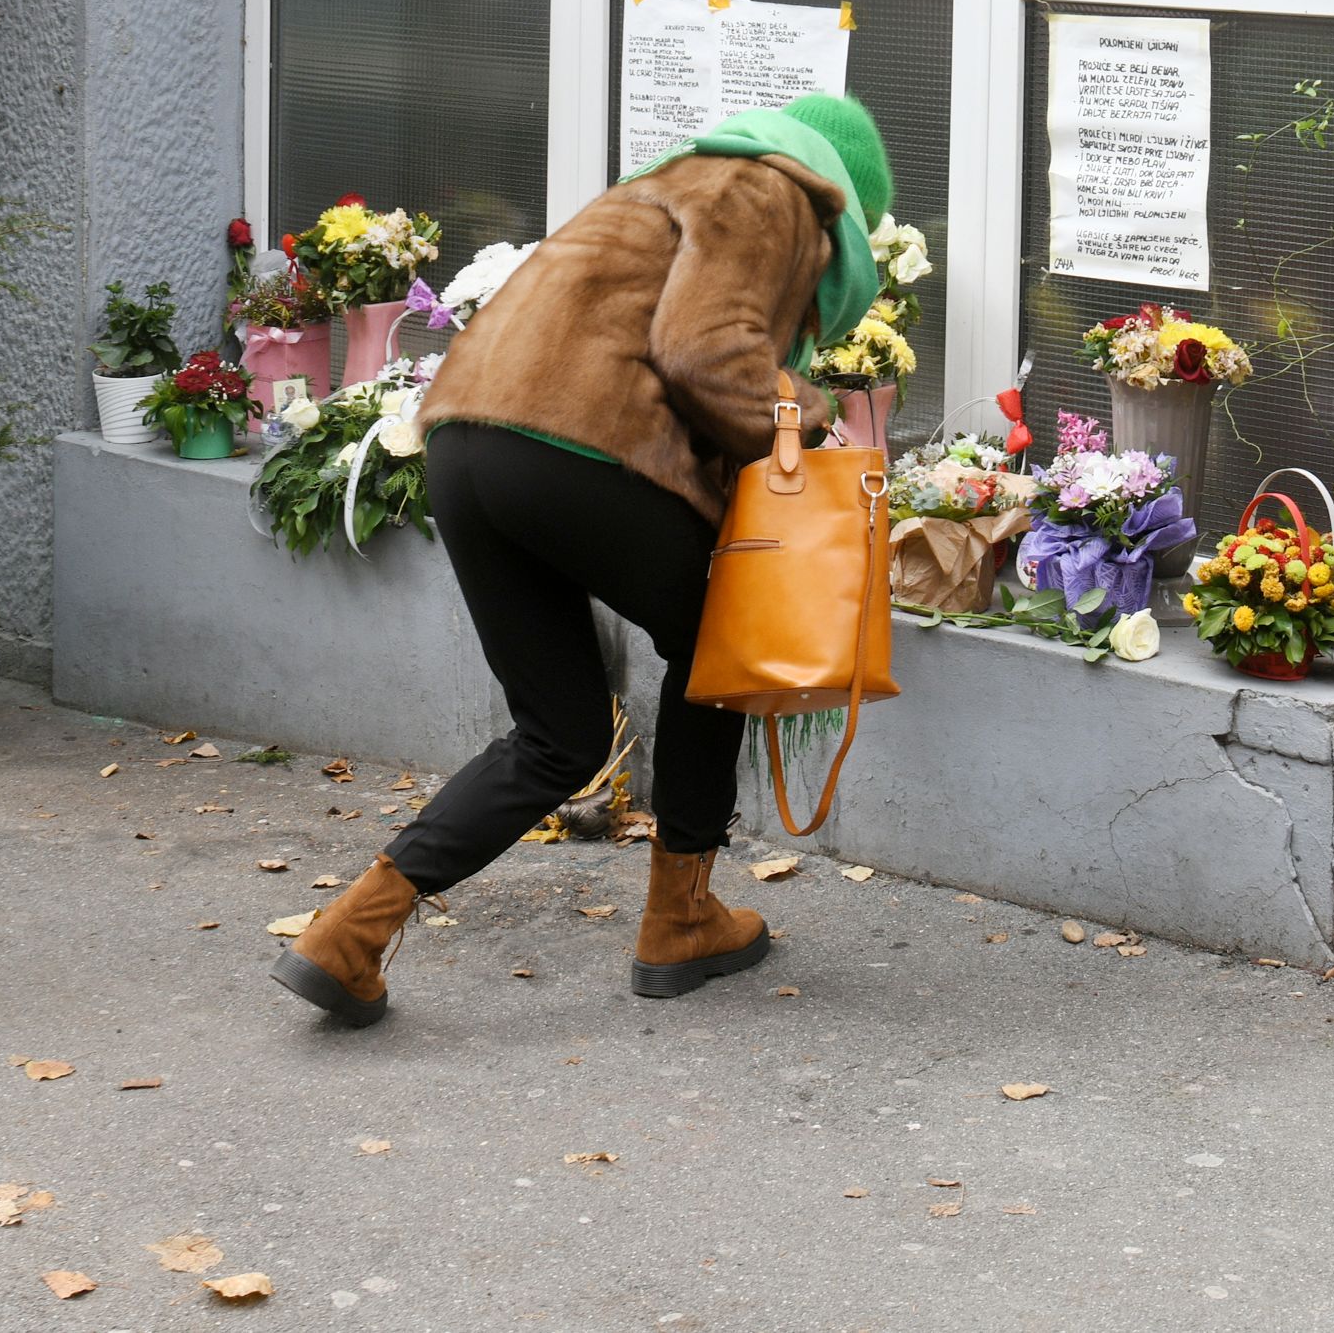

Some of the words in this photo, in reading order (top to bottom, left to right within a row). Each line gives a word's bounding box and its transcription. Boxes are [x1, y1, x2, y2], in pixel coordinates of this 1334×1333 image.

[1114, 63, 1126, 72] SE
[1113, 234, 1122, 242] SE
[1086, 248, 1106, 256] TUGA
[1107, 251, 1119, 259] ZA
